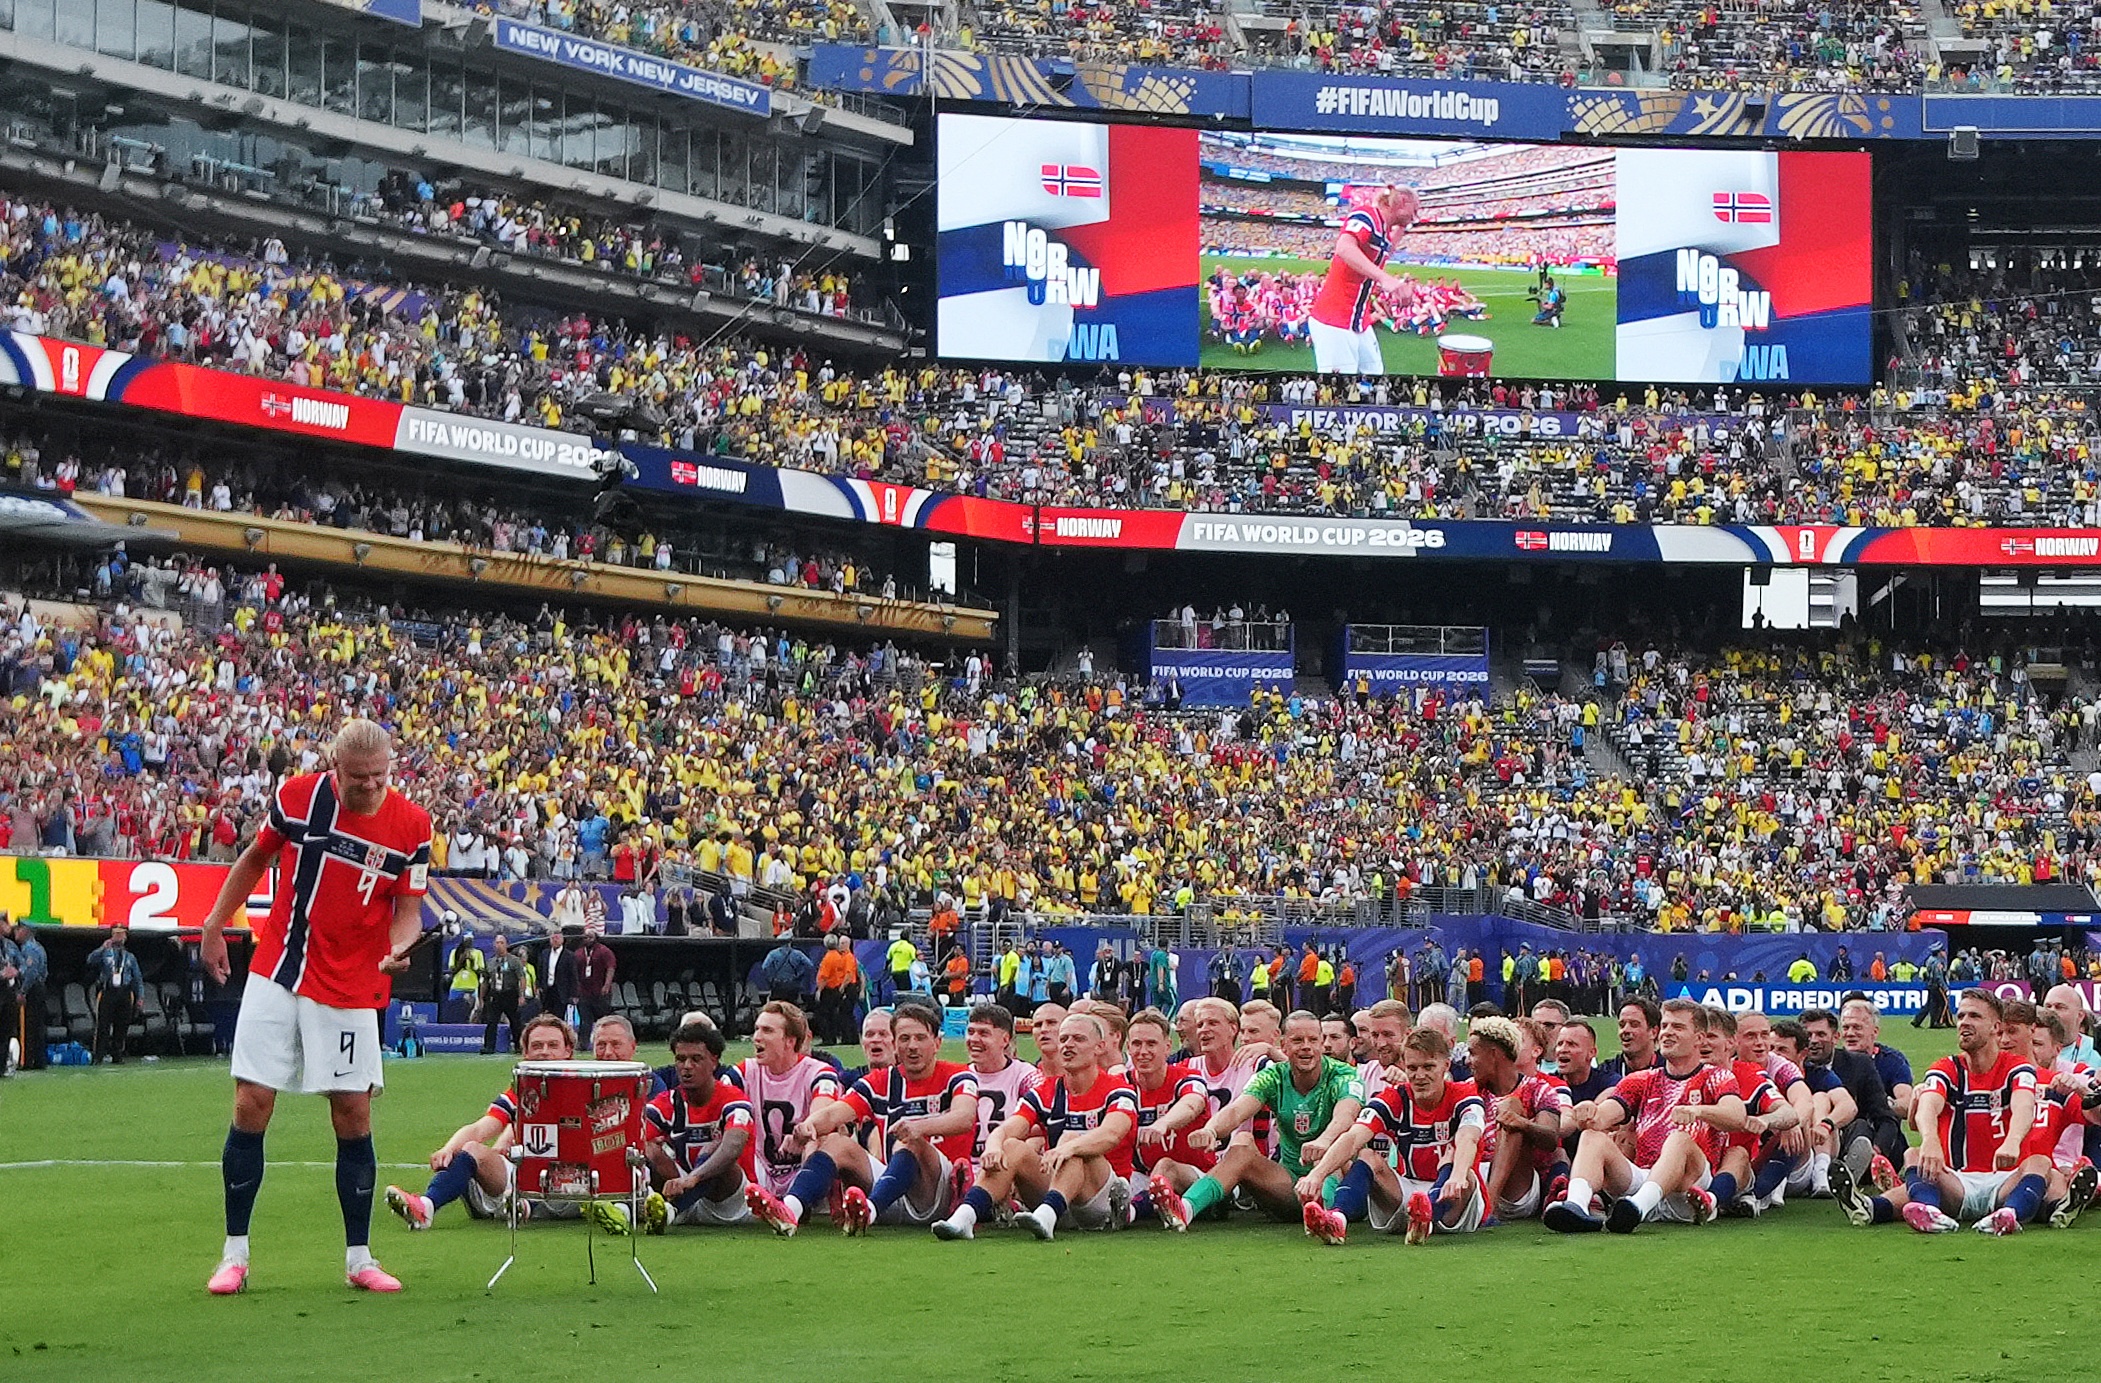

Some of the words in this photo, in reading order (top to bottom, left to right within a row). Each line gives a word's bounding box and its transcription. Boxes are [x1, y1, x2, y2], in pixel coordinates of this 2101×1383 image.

[508, 27, 560, 54] NEW
[564, 41, 624, 71] YORK
[628, 58, 676, 83] NEW
[680, 74, 759, 104] JERSEY
[1316, 86, 1499, 126] #FIFAWorldCup
[292, 396, 349, 430] NORWAY
[409, 418, 450, 447] FIFA
[451, 425, 518, 457] WORLD
[519, 437, 556, 462] CUP
[697, 465, 747, 493] NORWAY
[1057, 517, 1122, 538] NORWAY
[1194, 522, 1240, 541] FIFA
[1242, 524, 1319, 544] WORLD
[1322, 528, 1365, 546] CUP
[1369, 529, 1445, 548] 2026
[1550, 531, 1612, 551] NORWAY
[2035, 537, 2099, 556] NORWAY
[1151, 665, 1178, 677] FIFA
[1179, 666, 1224, 677] WORLD
[1225, 667, 1249, 678] CUP
[1251, 668, 1293, 679] 2026
[1375, 669, 1419, 680] WORLD
[1420, 670, 1445, 681] CUP
[1447, 671, 1489, 682] 2026
[16, 857, 62, 925] 1
[128, 861, 179, 929] 2
[357, 870, 379, 906] 9
[1701, 988, 1763, 1012] ADI
[340, 1031, 356, 1065] 9
[1990, 1110, 2006, 1139] 3
